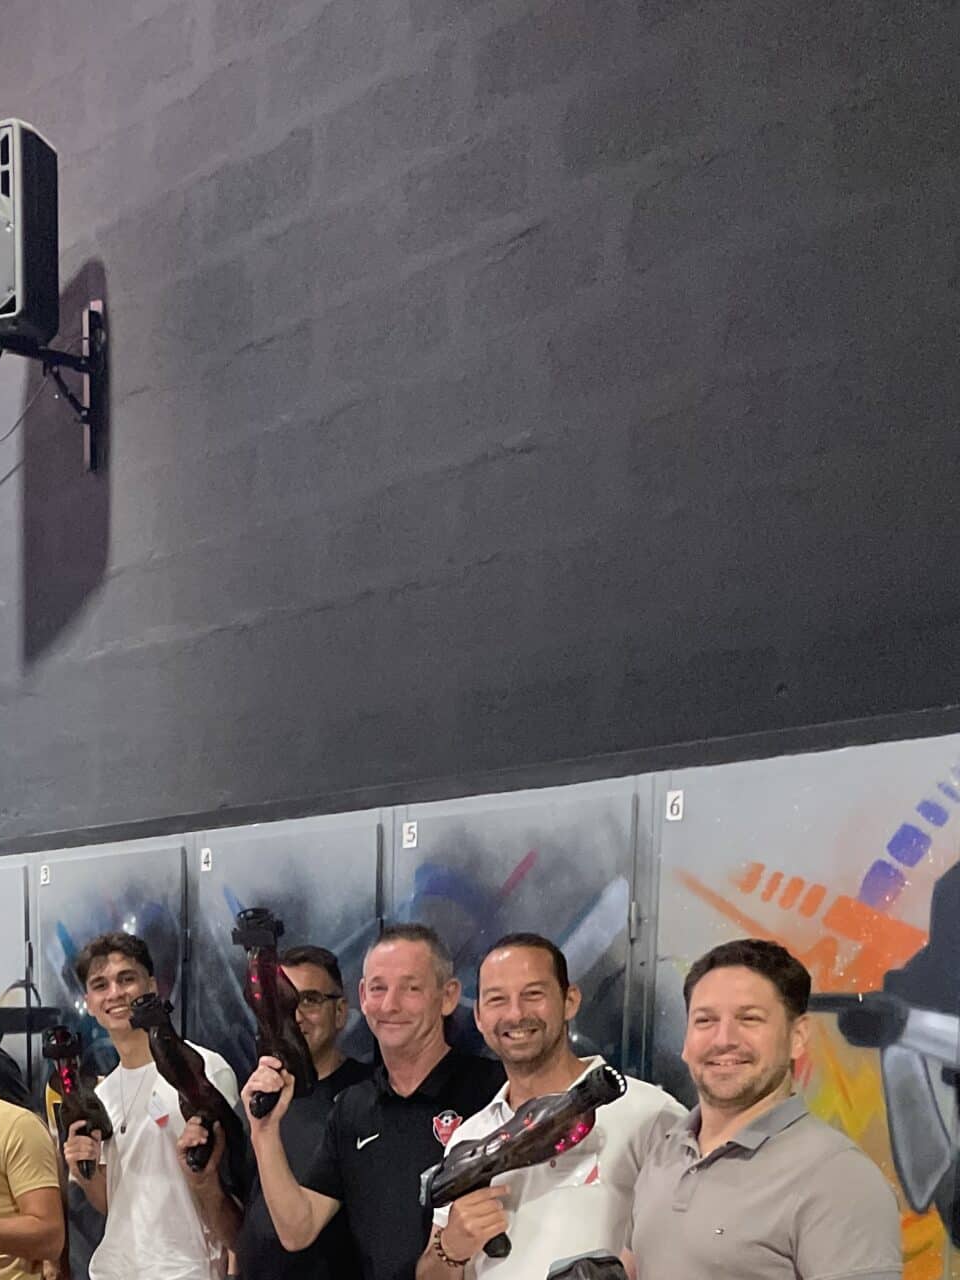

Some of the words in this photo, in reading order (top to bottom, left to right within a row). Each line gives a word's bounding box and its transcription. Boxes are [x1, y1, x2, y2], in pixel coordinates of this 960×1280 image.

[670, 795, 680, 816] 6
[407, 825, 416, 843] 5
[203, 851, 211, 868] 4
